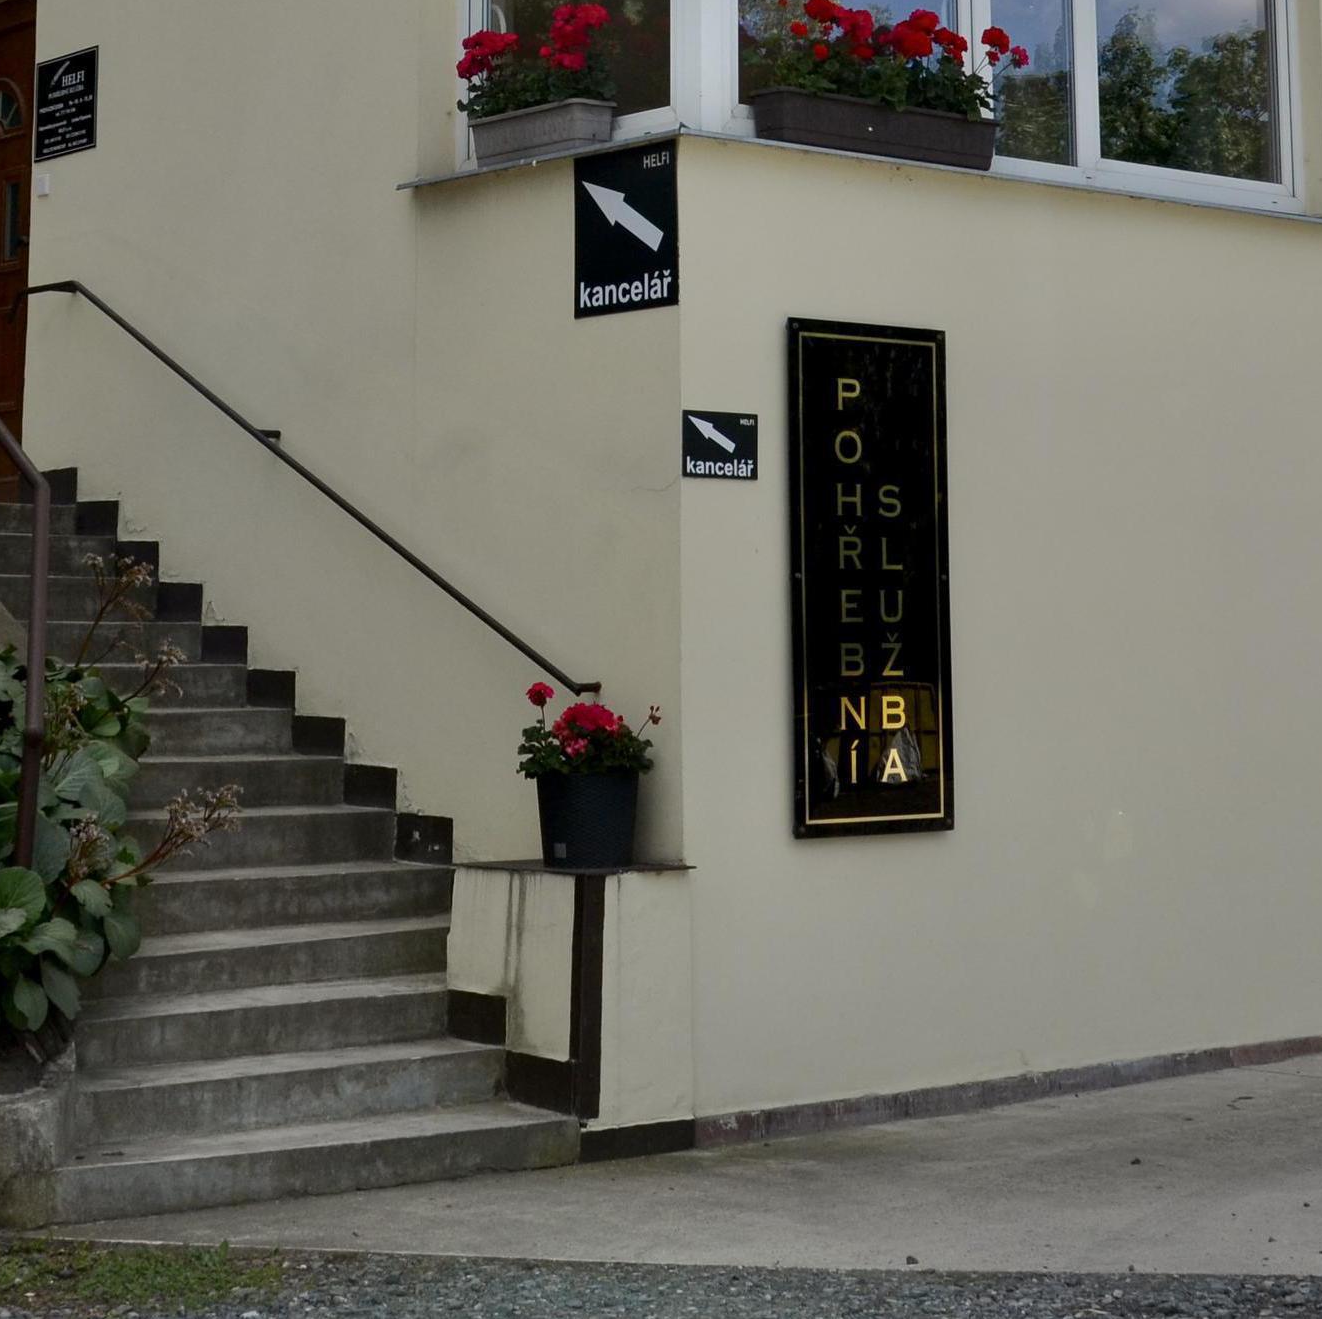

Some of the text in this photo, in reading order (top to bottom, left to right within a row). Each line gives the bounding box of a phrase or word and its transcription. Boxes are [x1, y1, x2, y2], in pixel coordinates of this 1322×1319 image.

[61, 70, 85, 87] HELFI
[643, 151, 670, 170] HELFI
[579, 269, 672, 309] kancelář
[686, 456, 754, 477] kancelář
